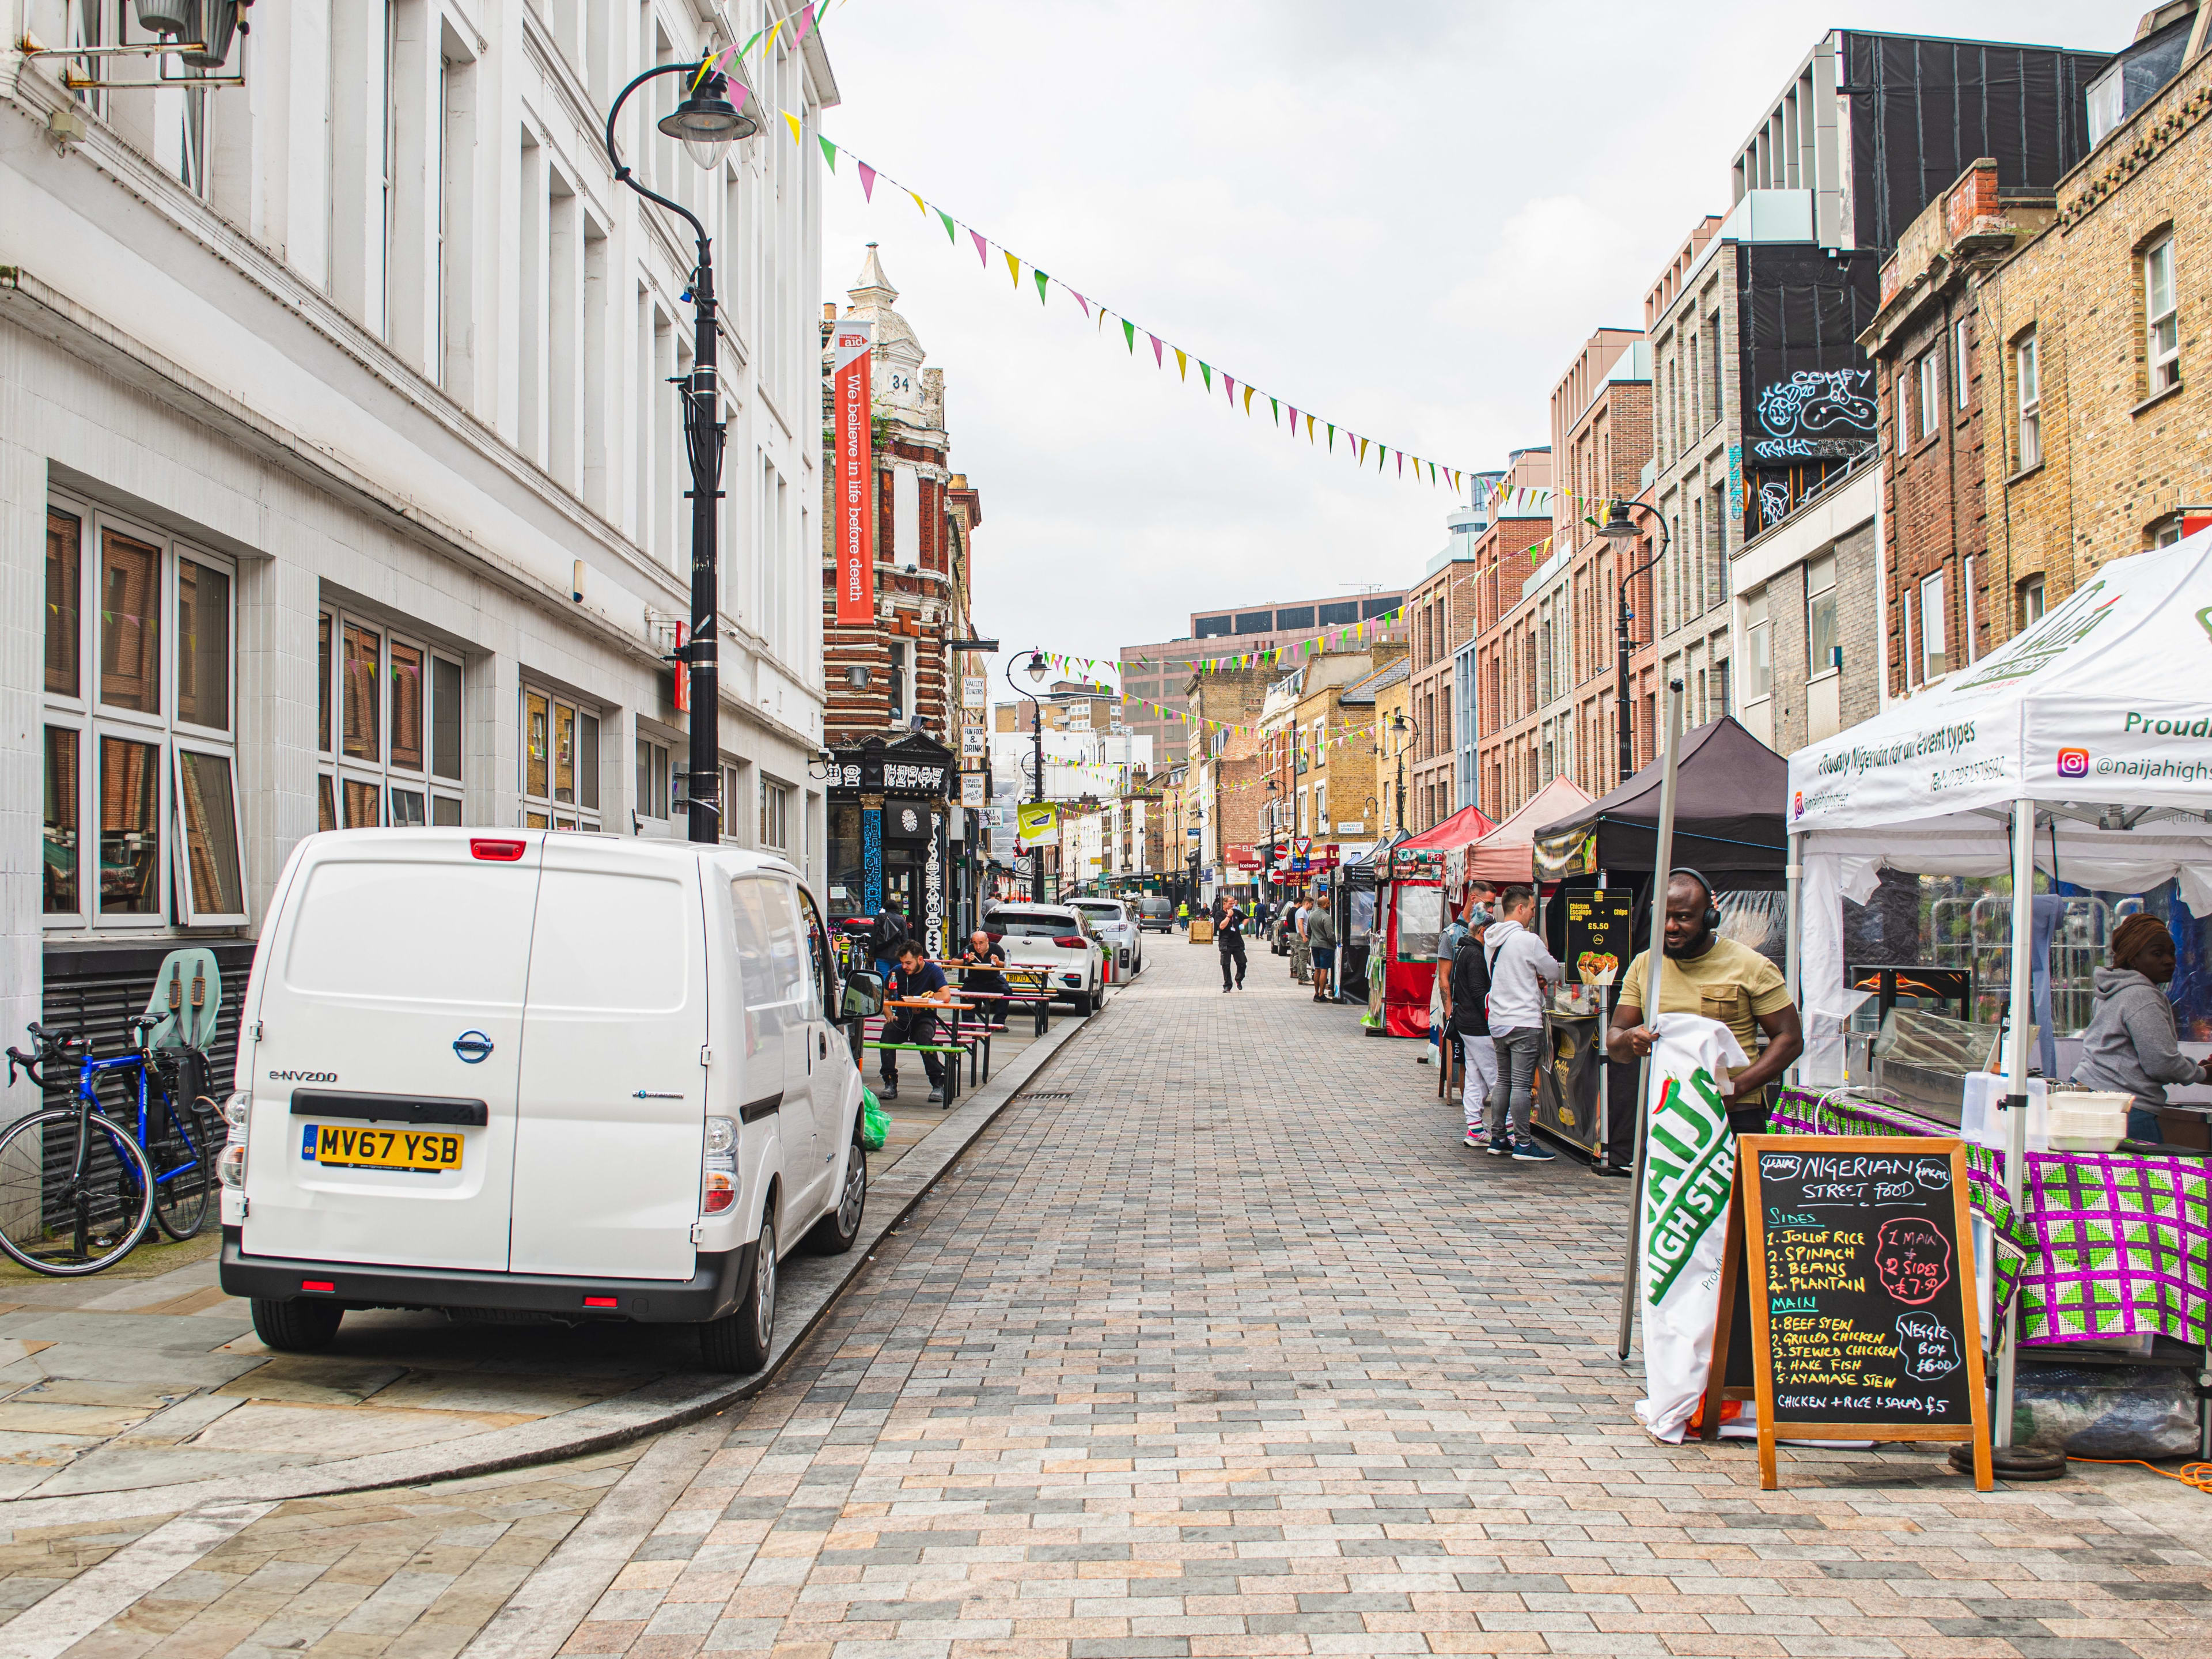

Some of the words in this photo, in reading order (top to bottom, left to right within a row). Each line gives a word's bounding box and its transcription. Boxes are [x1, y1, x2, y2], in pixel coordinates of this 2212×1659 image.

[845, 337, 863, 346] aid
[848, 374, 861, 399] We
[893, 375, 909, 392] 34
[1791, 369, 1871, 387] COMFY
[848, 403, 861, 457] believe
[849, 461, 861, 476] in
[849, 480, 862, 503] life
[849, 507, 862, 554] before
[849, 558, 863, 602] death
[965, 679, 983, 687] VAULTY
[964, 744, 983, 752] DRINK
[1818, 751, 1850, 778] Proudly
[1851, 746, 1888, 776] Nigerian
[1889, 739, 1901, 766] for
[1917, 725, 1945, 756] event
[1946, 720, 1975, 755] types
[1008, 974, 1026, 982] BD70
[457, 1041, 490, 1050] NISSAN
[270, 1070, 337, 1082] e-NV200
[321, 1128, 396, 1159] MV67
[404, 1134, 458, 1164] YSB
[1647, 1066, 1726, 1224] AIJA
[1802, 1157, 1913, 1181] NIGERIAN
[1802, 1183, 1869, 1198] STREET
[1873, 1181, 1914, 1199] FOOD
[1767, 1207, 1816, 1224] SIDES
[1781, 1229, 1831, 1244] JOLLOF
[1834, 1230, 1866, 1246] RICE
[1903, 1232, 1938, 1246] MAIN
[1767, 1250, 1783, 1262] 2.
[1785, 1246, 1855, 1261] SPINACH
[1769, 1264, 1784, 1279] 3.
[1788, 1262, 1847, 1278] BEANS
[1903, 1260, 1940, 1277] SIDES
[1768, 1280, 1788, 1294] 4.
[1790, 1277, 1866, 1293] PLANTAIN
[1772, 1296, 1816, 1310] MAIN
[1783, 1316, 1816, 1331] BEEF
[1818, 1316, 1854, 1332] STEW
[1899, 1320, 1950, 1342] VEGGIE
[1783, 1332, 1830, 1347] GRILLED
[1832, 1331, 1886, 1344] CHICKEN
[1772, 1347, 1787, 1359] 3.
[1788, 1346, 1842, 1358] STEWED
[1845, 1344, 1899, 1359] CHICKEN
[1774, 1360, 1786, 1373] 4.
[1790, 1359, 1823, 1371] HAKE
[1830, 1358, 1862, 1371] FISH
[1790, 1372, 1858, 1385] AYAMASE
[1862, 1373, 1897, 1389] STEW
[1778, 1394, 1827, 1409] CHICKEN
[1884, 1396, 1923, 1411] SALAD
[1925, 1396, 1950, 1415] £5
